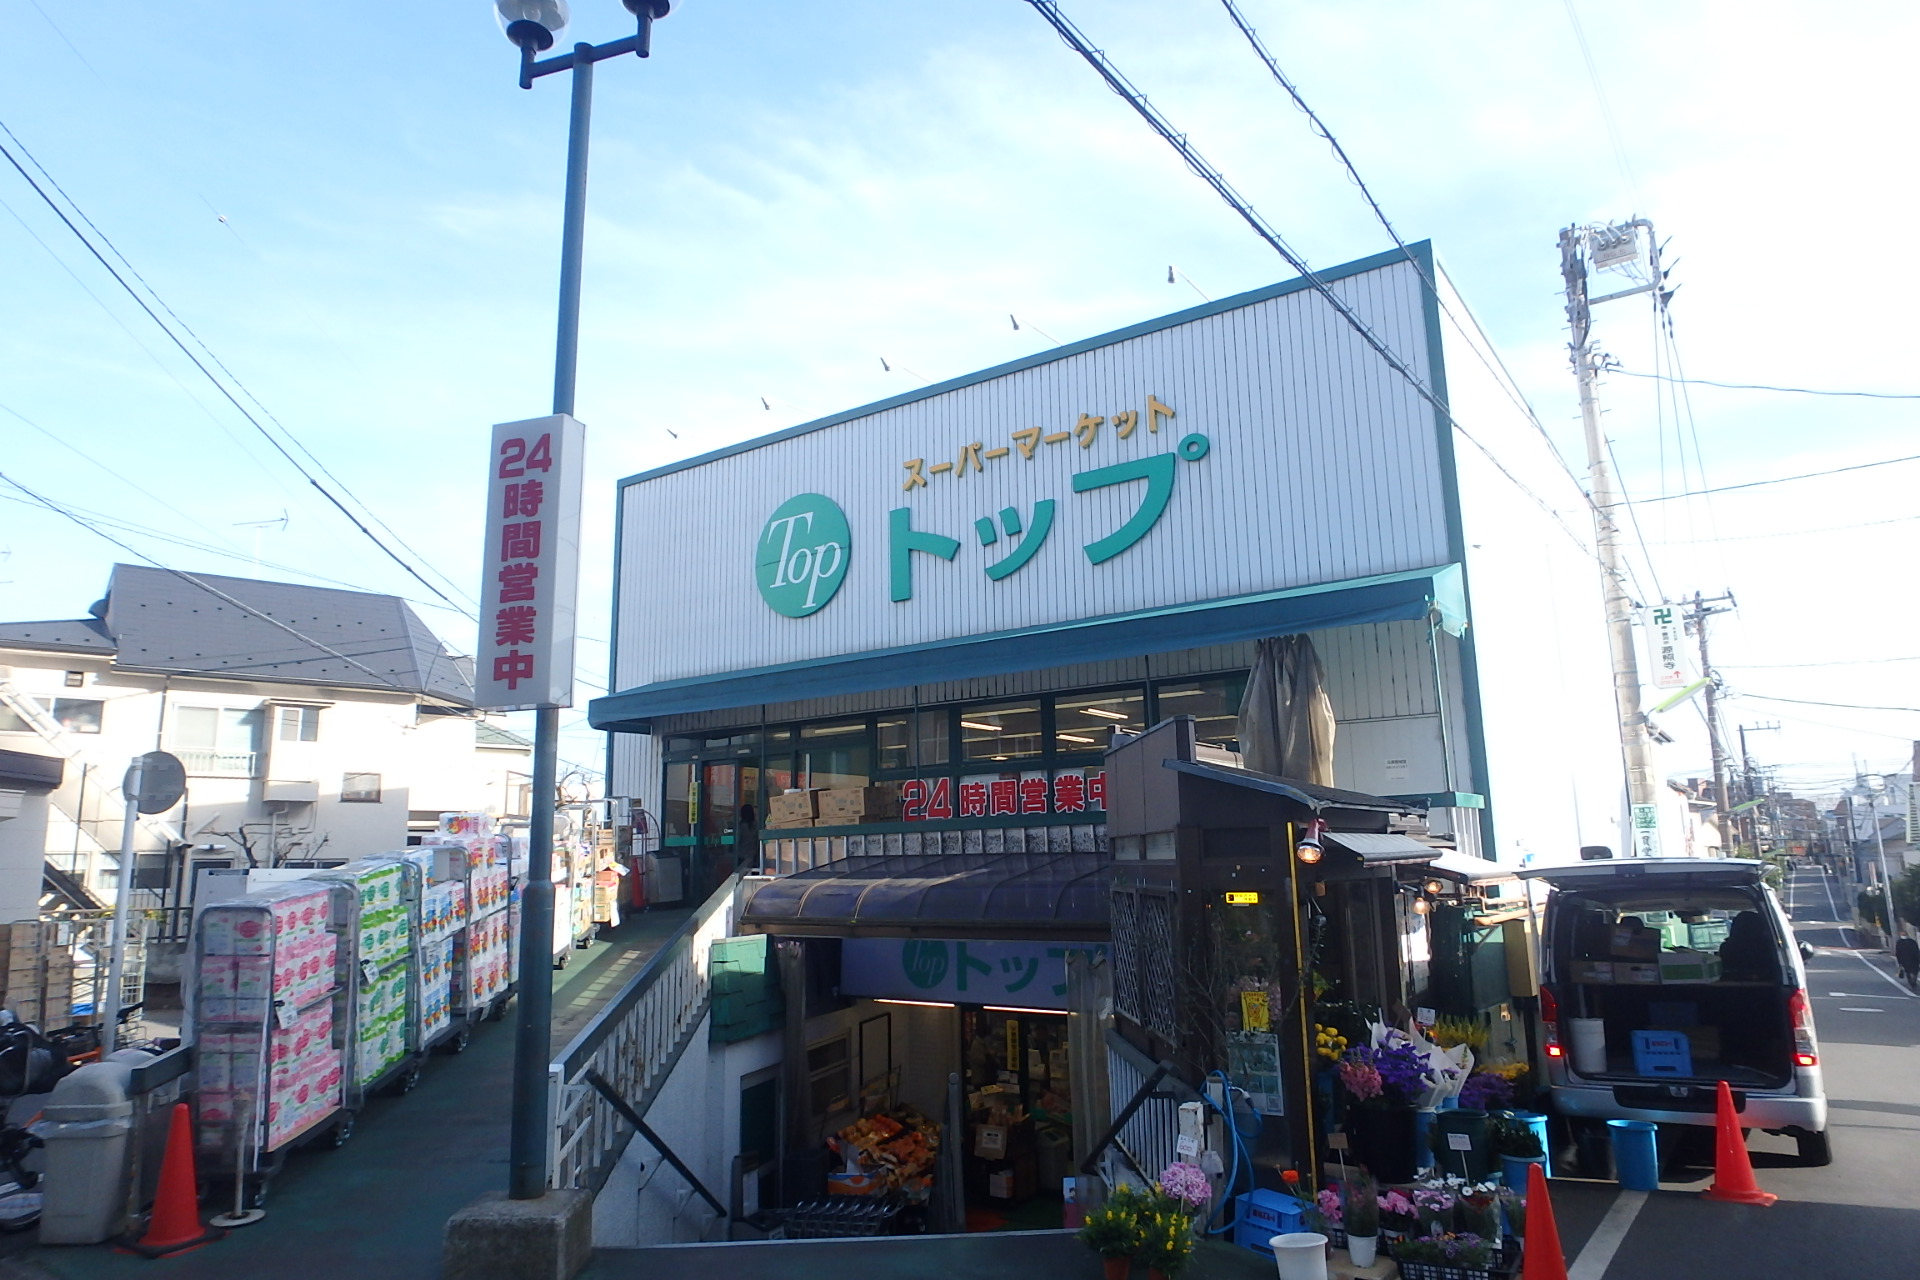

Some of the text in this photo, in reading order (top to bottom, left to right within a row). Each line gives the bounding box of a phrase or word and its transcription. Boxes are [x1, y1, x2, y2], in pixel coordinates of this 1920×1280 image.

[903, 395, 1175, 491] スーパーマーケット
[493, 433, 552, 690] 24時間営業中
[766, 511, 842, 609] Top
[890, 433, 1210, 603] トップ
